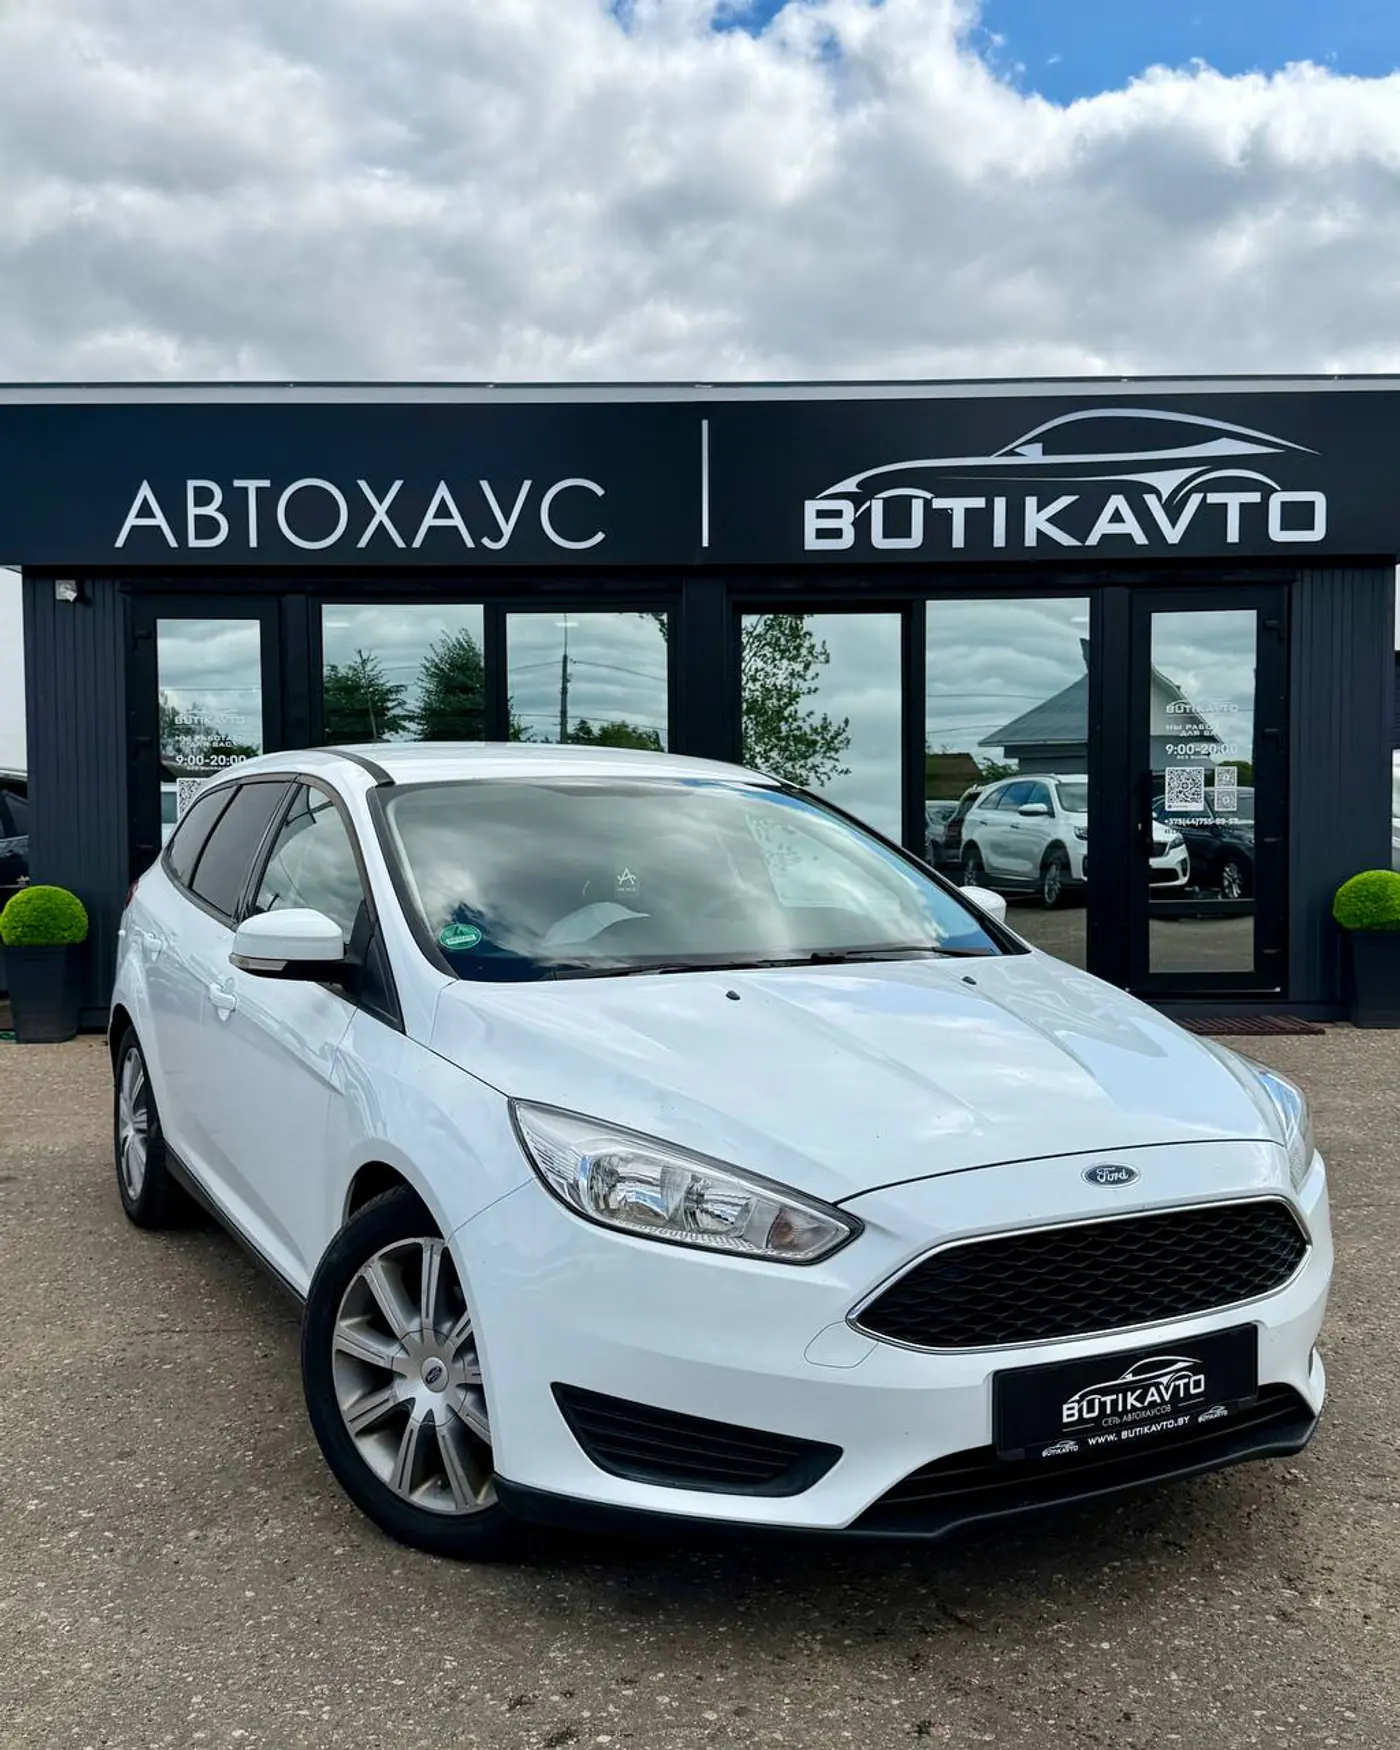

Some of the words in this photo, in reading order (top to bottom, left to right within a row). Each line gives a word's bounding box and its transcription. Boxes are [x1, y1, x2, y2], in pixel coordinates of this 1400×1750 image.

[114, 477, 607, 551] АВТОХАУС
[804, 490, 1327, 550] BUTIKAVTO
[176, 755, 246, 765] 9:00-20:00
[1166, 744, 1237, 754] 9:00-20:00
[1097, 1167, 1128, 1182] Ford
[1062, 1374, 1205, 1423] BUTIKAVTO
[1101, 1414, 1121, 1428] СЕТЬ
[1121, 1404, 1172, 1423] АВТОХАУСОВ
[1121, 1415, 1191, 1440] BUTIKAVTO.BY
